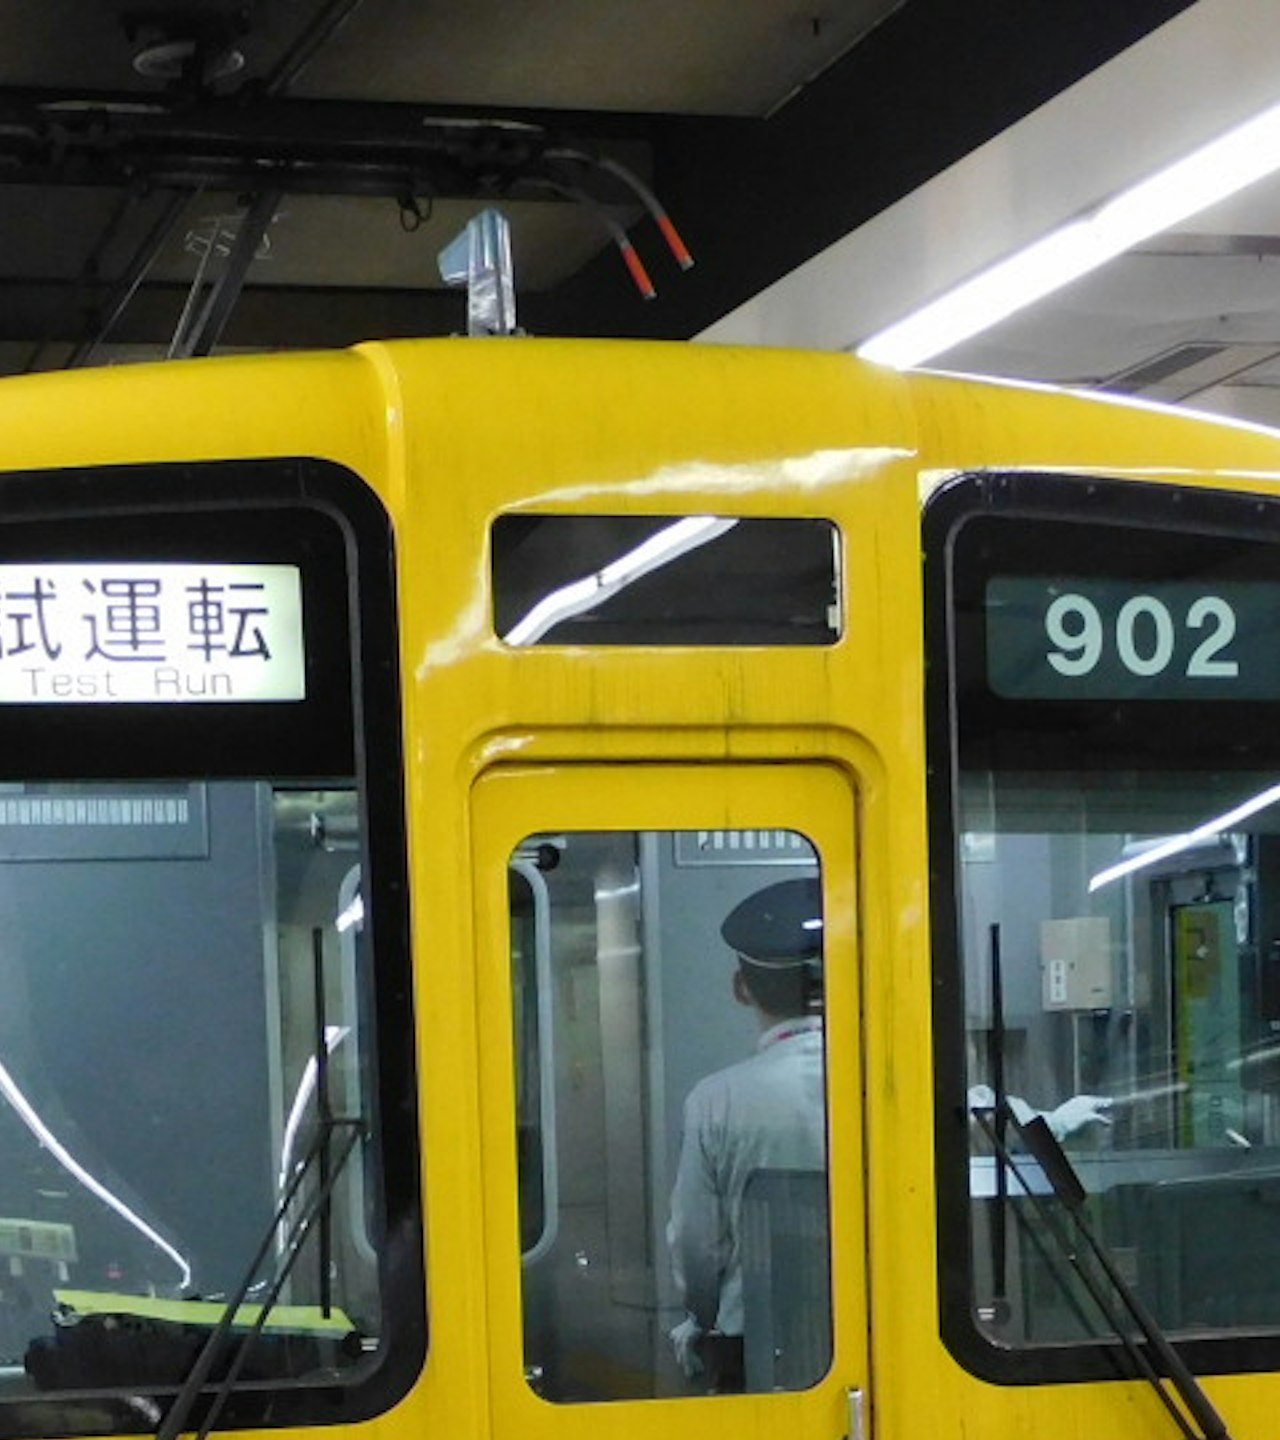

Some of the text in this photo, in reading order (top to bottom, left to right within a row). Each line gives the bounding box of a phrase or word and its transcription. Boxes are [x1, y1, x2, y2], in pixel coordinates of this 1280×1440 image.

[1044, 593, 1240, 678] 902
[20, 667, 234, 698] Test Run
